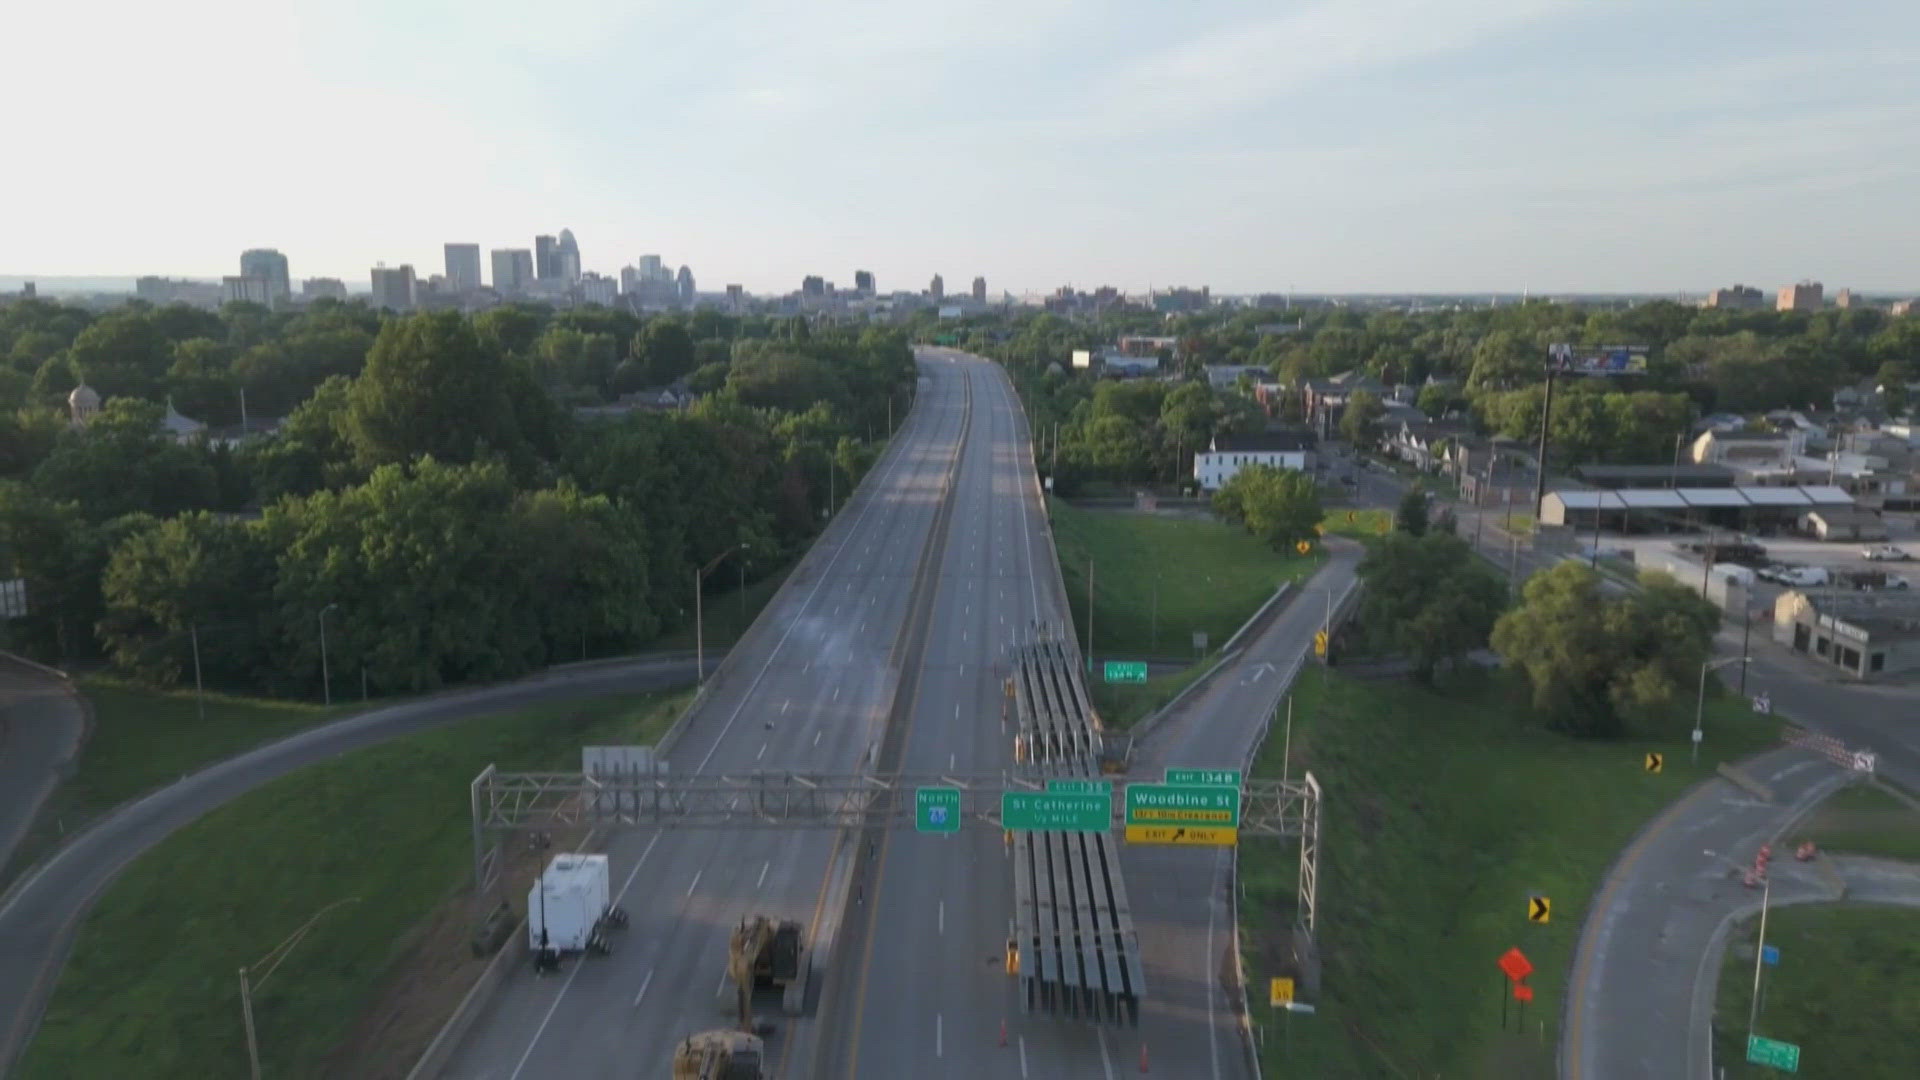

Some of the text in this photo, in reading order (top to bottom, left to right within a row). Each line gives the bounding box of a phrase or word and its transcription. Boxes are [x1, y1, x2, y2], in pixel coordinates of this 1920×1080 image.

[1175, 771, 1233, 784] EXIT 134B
[919, 792, 958, 804] NORTH
[1135, 792, 1230, 807] Woodbine St
[1012, 799, 1102, 812] St Catherine
[1051, 814, 1079, 825] MILE
[1145, 829, 1217, 842] EXIT ONLY
